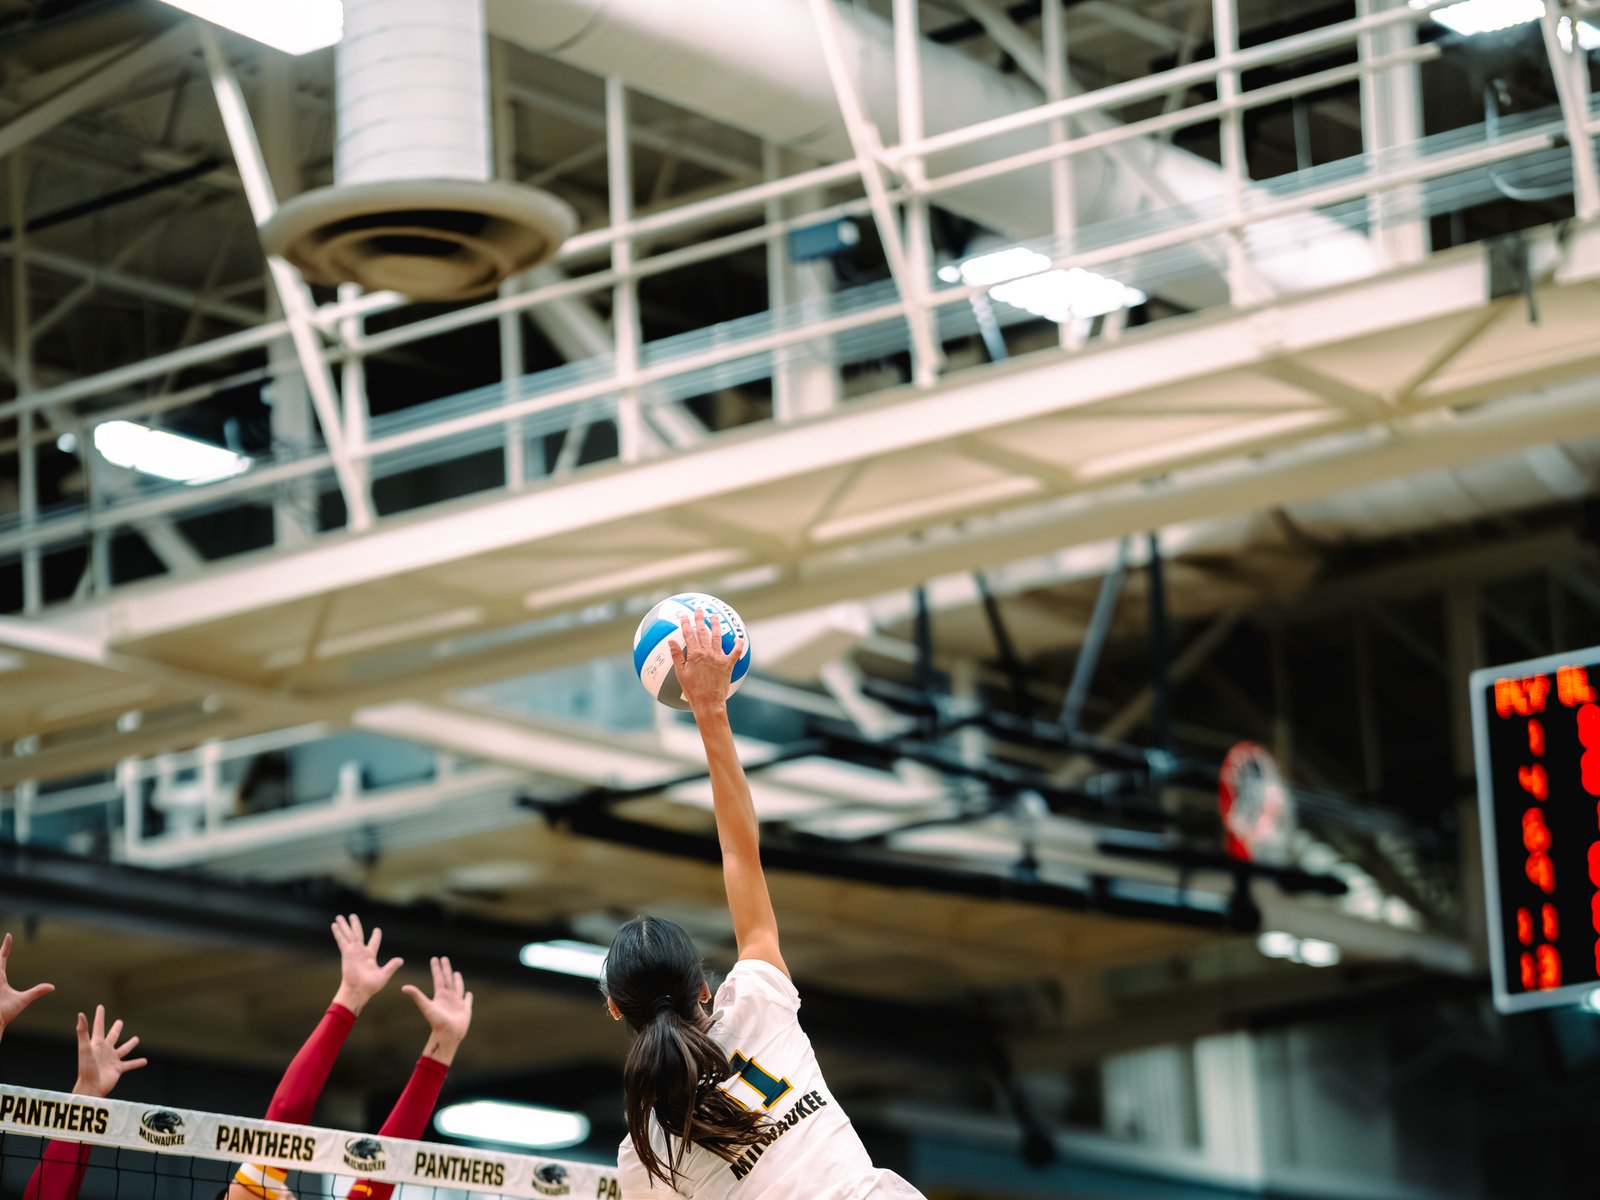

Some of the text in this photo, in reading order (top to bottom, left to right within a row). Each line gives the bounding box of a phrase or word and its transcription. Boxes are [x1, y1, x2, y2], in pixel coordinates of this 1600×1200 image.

[715, 1049, 794, 1120] 1
[0, 1094, 109, 1135] PANTHERS
[139, 1126, 185, 1146] MILWAUKEE
[216, 1125, 316, 1162] PANTHERS
[414, 1151, 505, 1187] PANTHERS
